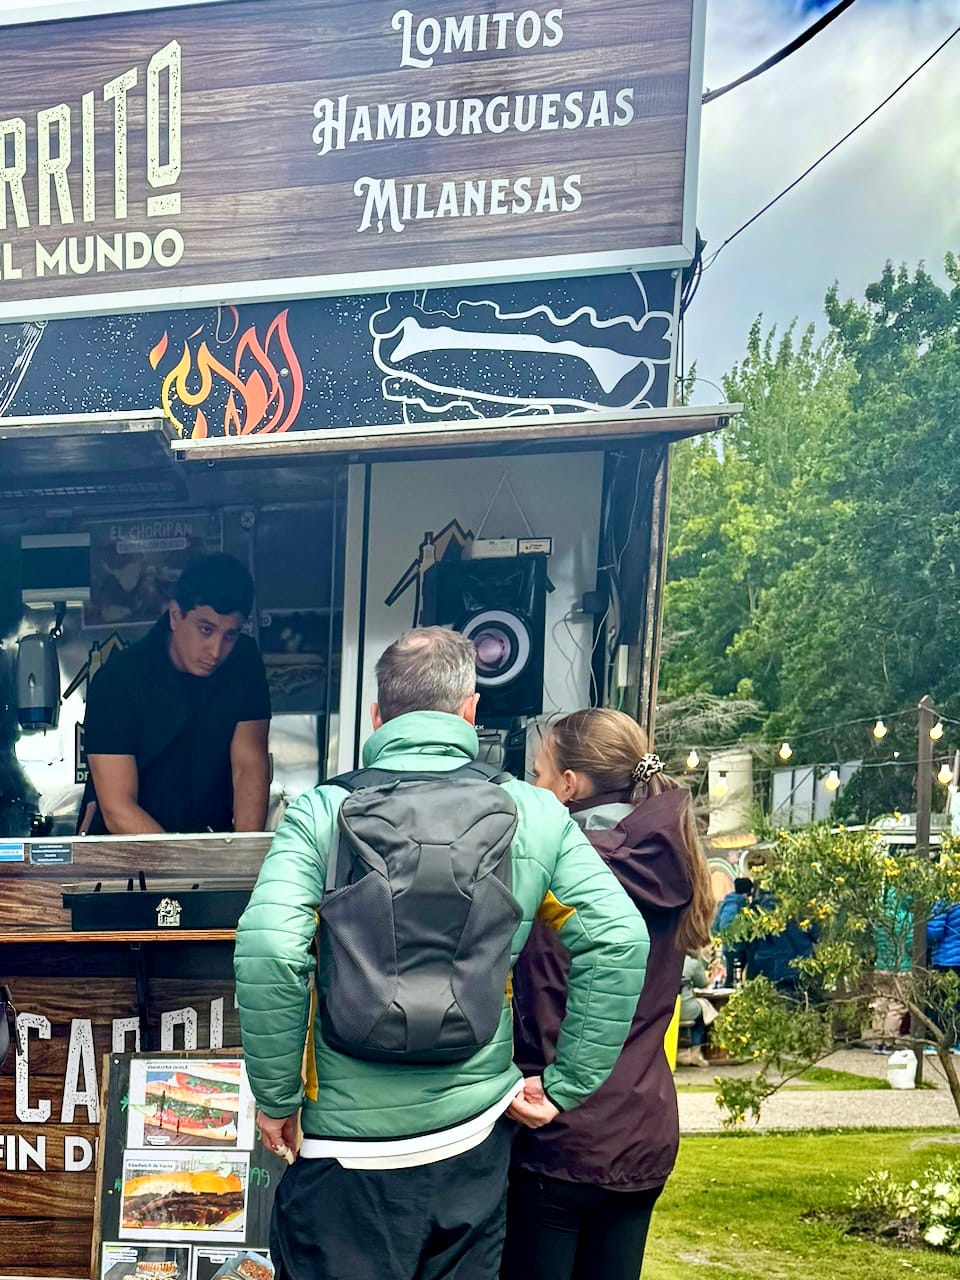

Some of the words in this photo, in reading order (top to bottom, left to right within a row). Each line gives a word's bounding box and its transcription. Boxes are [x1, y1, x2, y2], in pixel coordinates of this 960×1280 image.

[391, 9, 564, 69] LOMITOS
[312, 87, 635, 156] HAMBURGUESAS
[353, 174, 583, 234] MILANESAS
[35, 228, 186, 278] MUNDO
